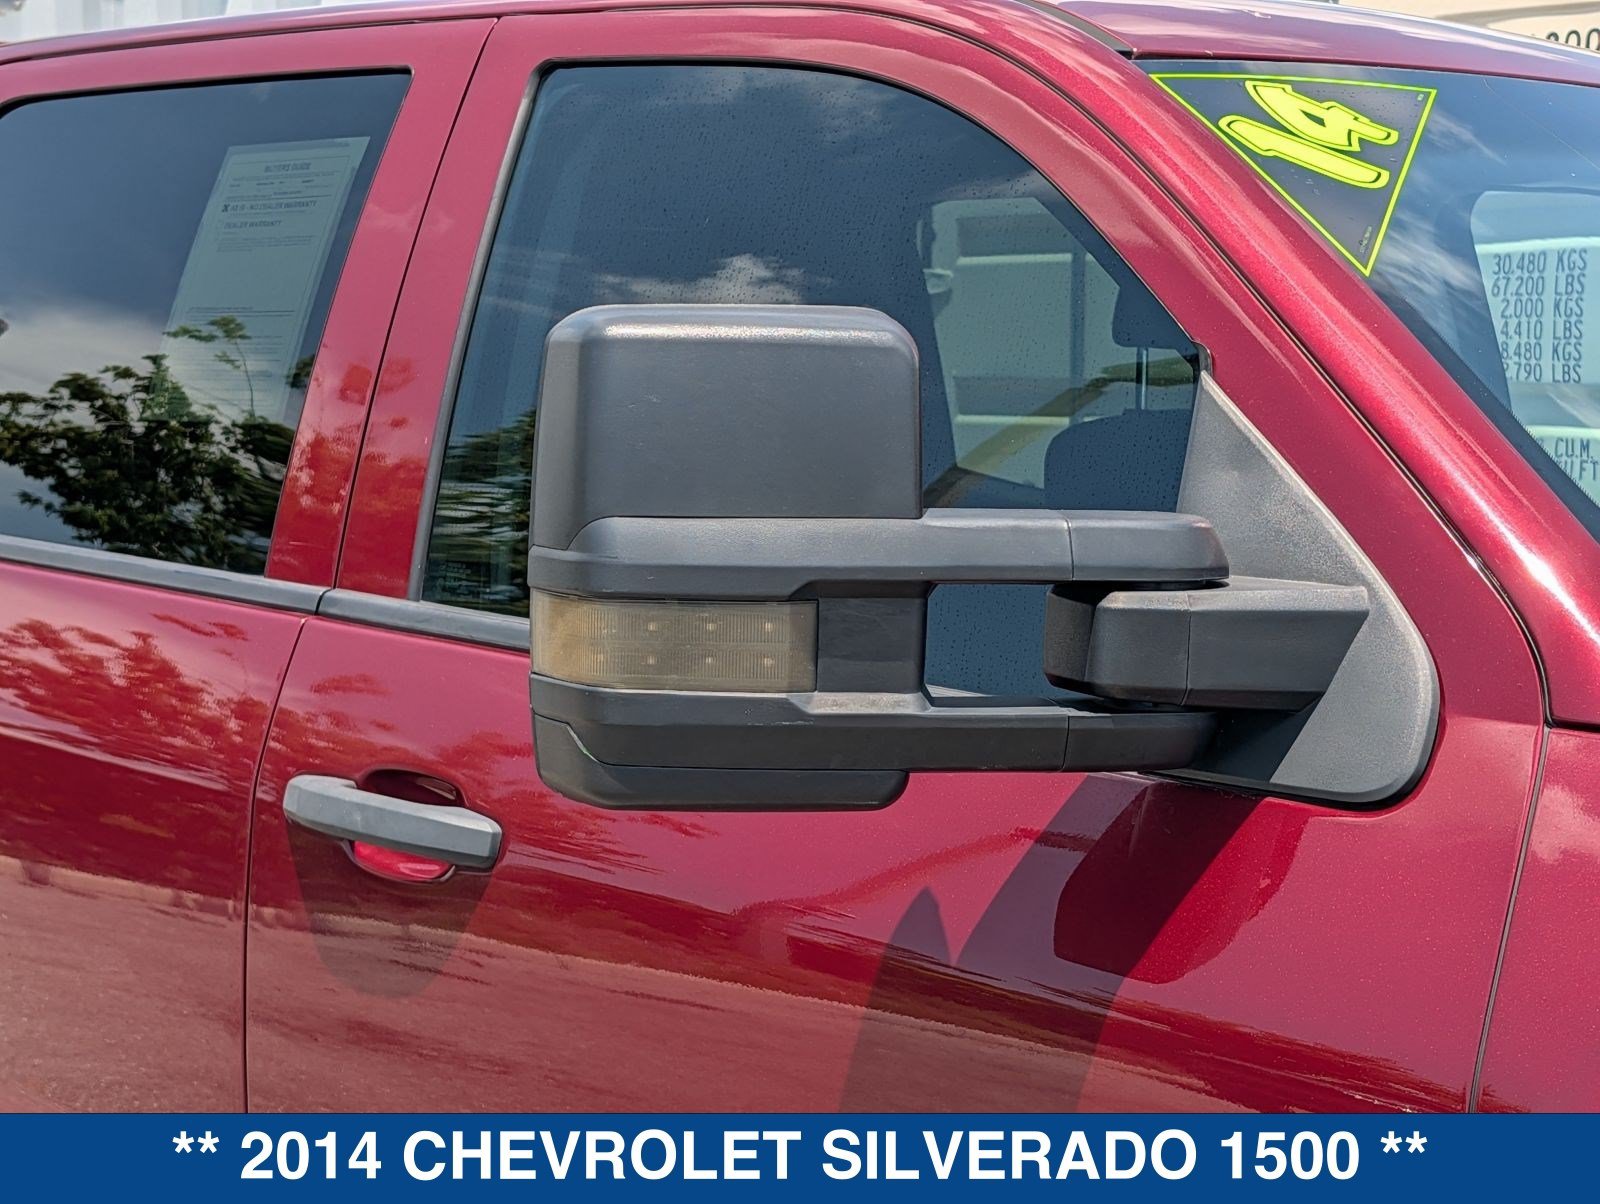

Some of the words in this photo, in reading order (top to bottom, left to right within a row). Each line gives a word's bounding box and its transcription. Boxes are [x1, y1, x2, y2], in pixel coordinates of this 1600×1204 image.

[1218, 80, 1400, 190] 14
[1556, 248, 1588, 273] KGS
[1554, 273, 1585, 297] LBS
[1553, 296, 1584, 319] KGS
[1552, 319, 1583, 341] LBS
[1552, 341, 1582, 362] KGS
[1551, 362, 1582, 383] LBS
